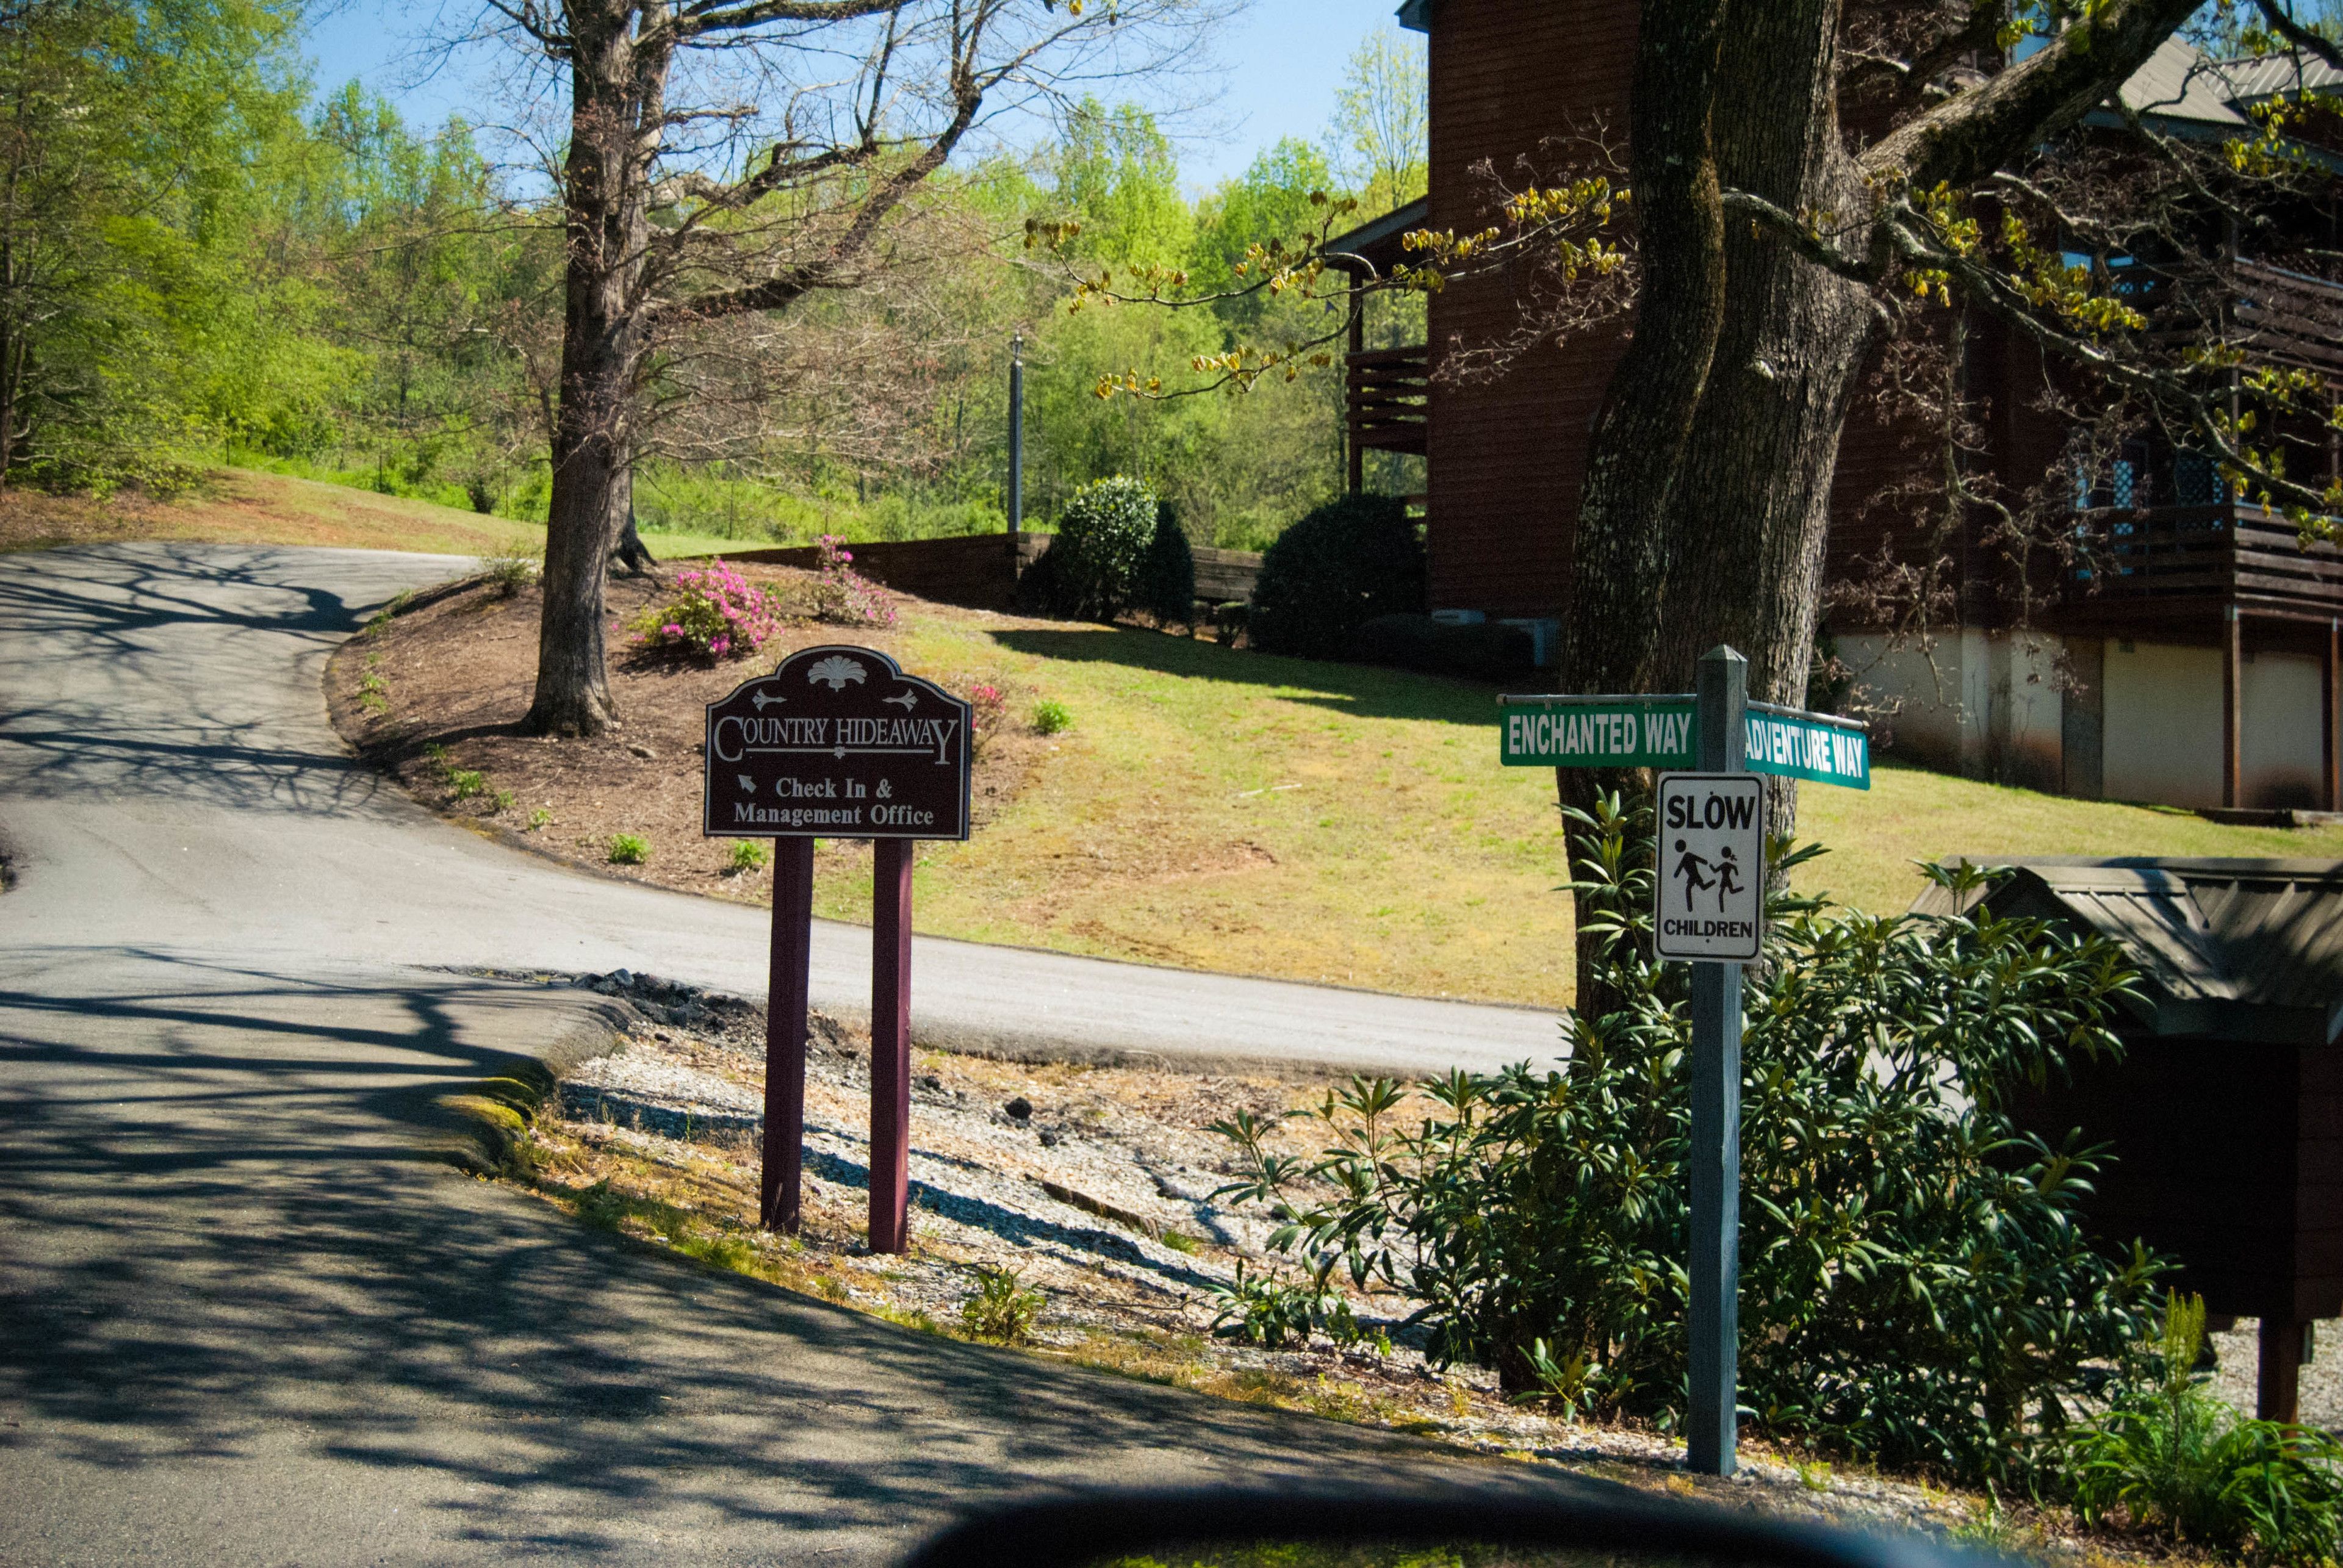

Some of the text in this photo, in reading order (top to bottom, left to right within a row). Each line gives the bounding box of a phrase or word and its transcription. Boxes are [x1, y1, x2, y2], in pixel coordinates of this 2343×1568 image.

[714, 716, 958, 764] COUNTRY HIDEAWAY
[1508, 712, 1692, 755] ENCHANTED WAY
[1745, 718, 1863, 778] ADVENTURE WAY
[776, 777, 893, 798] Check In &
[734, 802, 934, 826] Management Office
[1666, 794, 1755, 830] SLOW
[1663, 919, 1753, 938] CHILDREN
